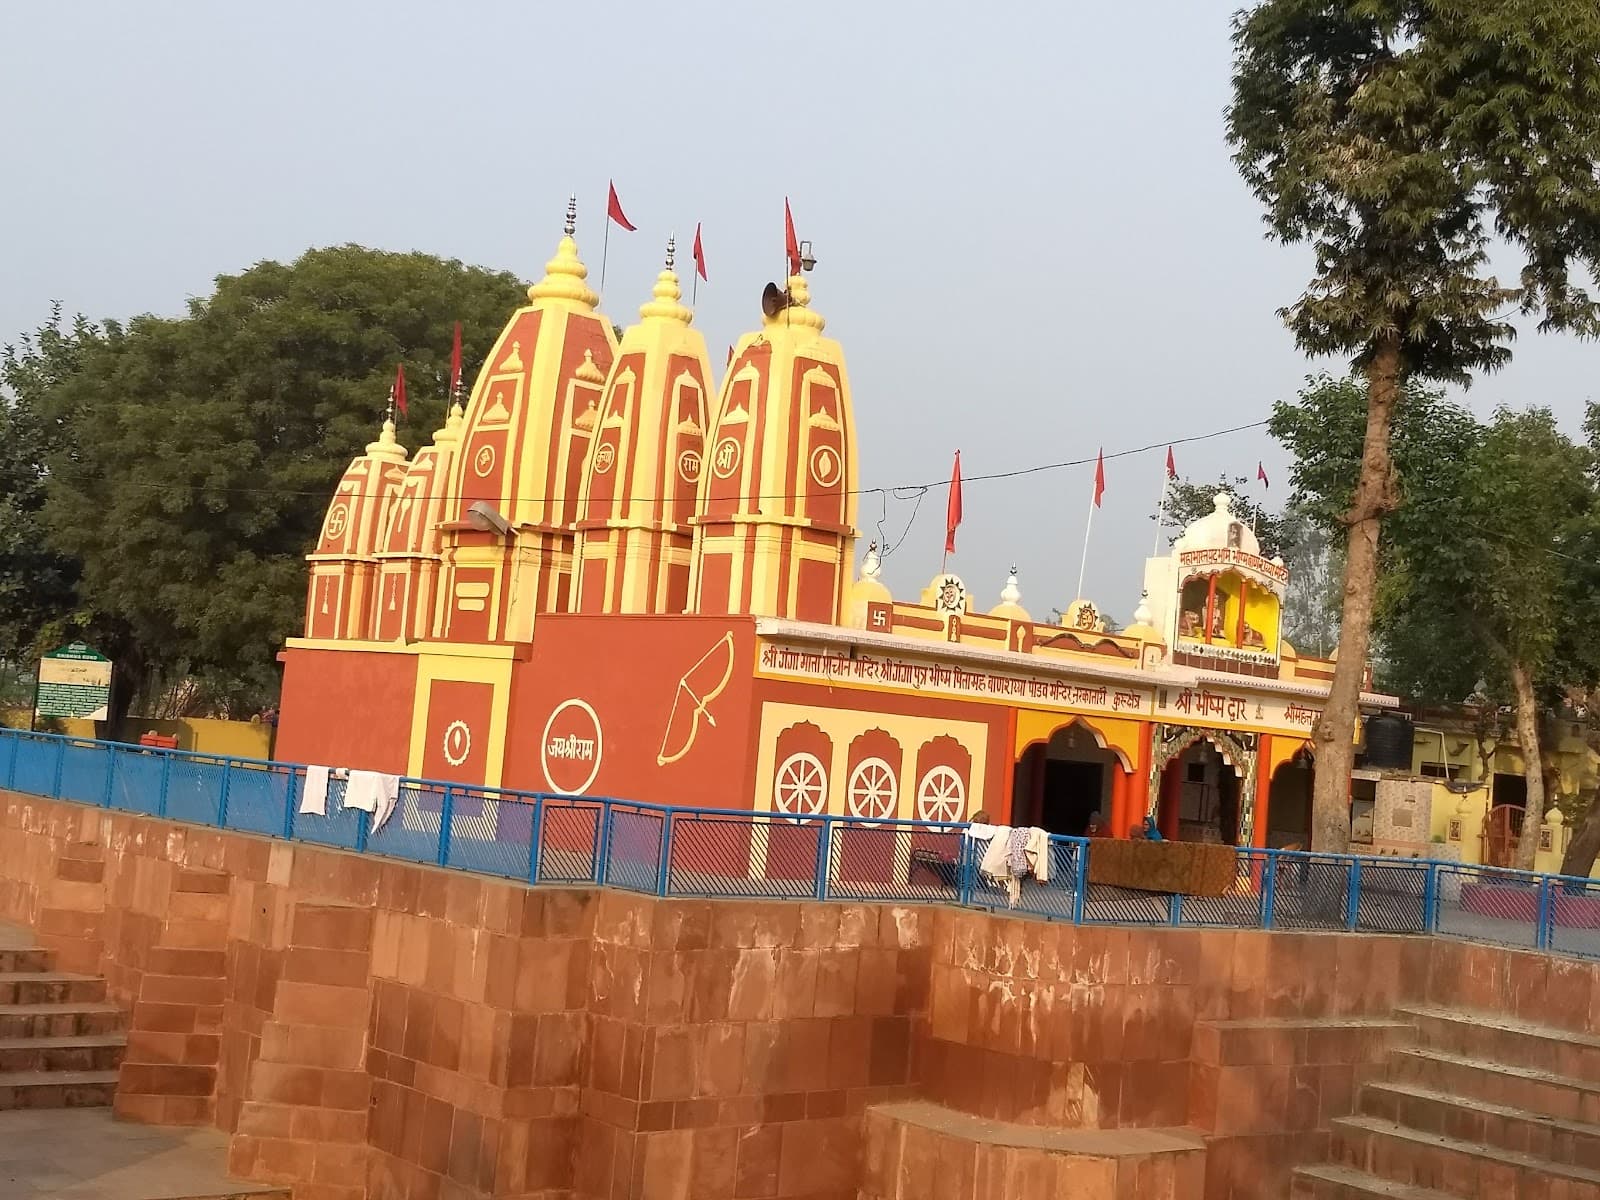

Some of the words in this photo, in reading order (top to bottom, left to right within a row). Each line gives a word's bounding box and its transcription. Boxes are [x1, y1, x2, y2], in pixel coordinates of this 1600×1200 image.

[762, 643, 778, 669] श्री
[779, 647, 799, 670] गंगा
[800, 652, 822, 674] माता
[881, 658, 893, 682] श्री
[893, 660, 913, 684] गंगा
[913, 666, 929, 689] पुत्र
[929, 663, 952, 687] भीष्म
[1175, 687, 1193, 715] श्री
[1194, 689, 1225, 718] भीष्म
[1227, 696, 1248, 722] द्वार
